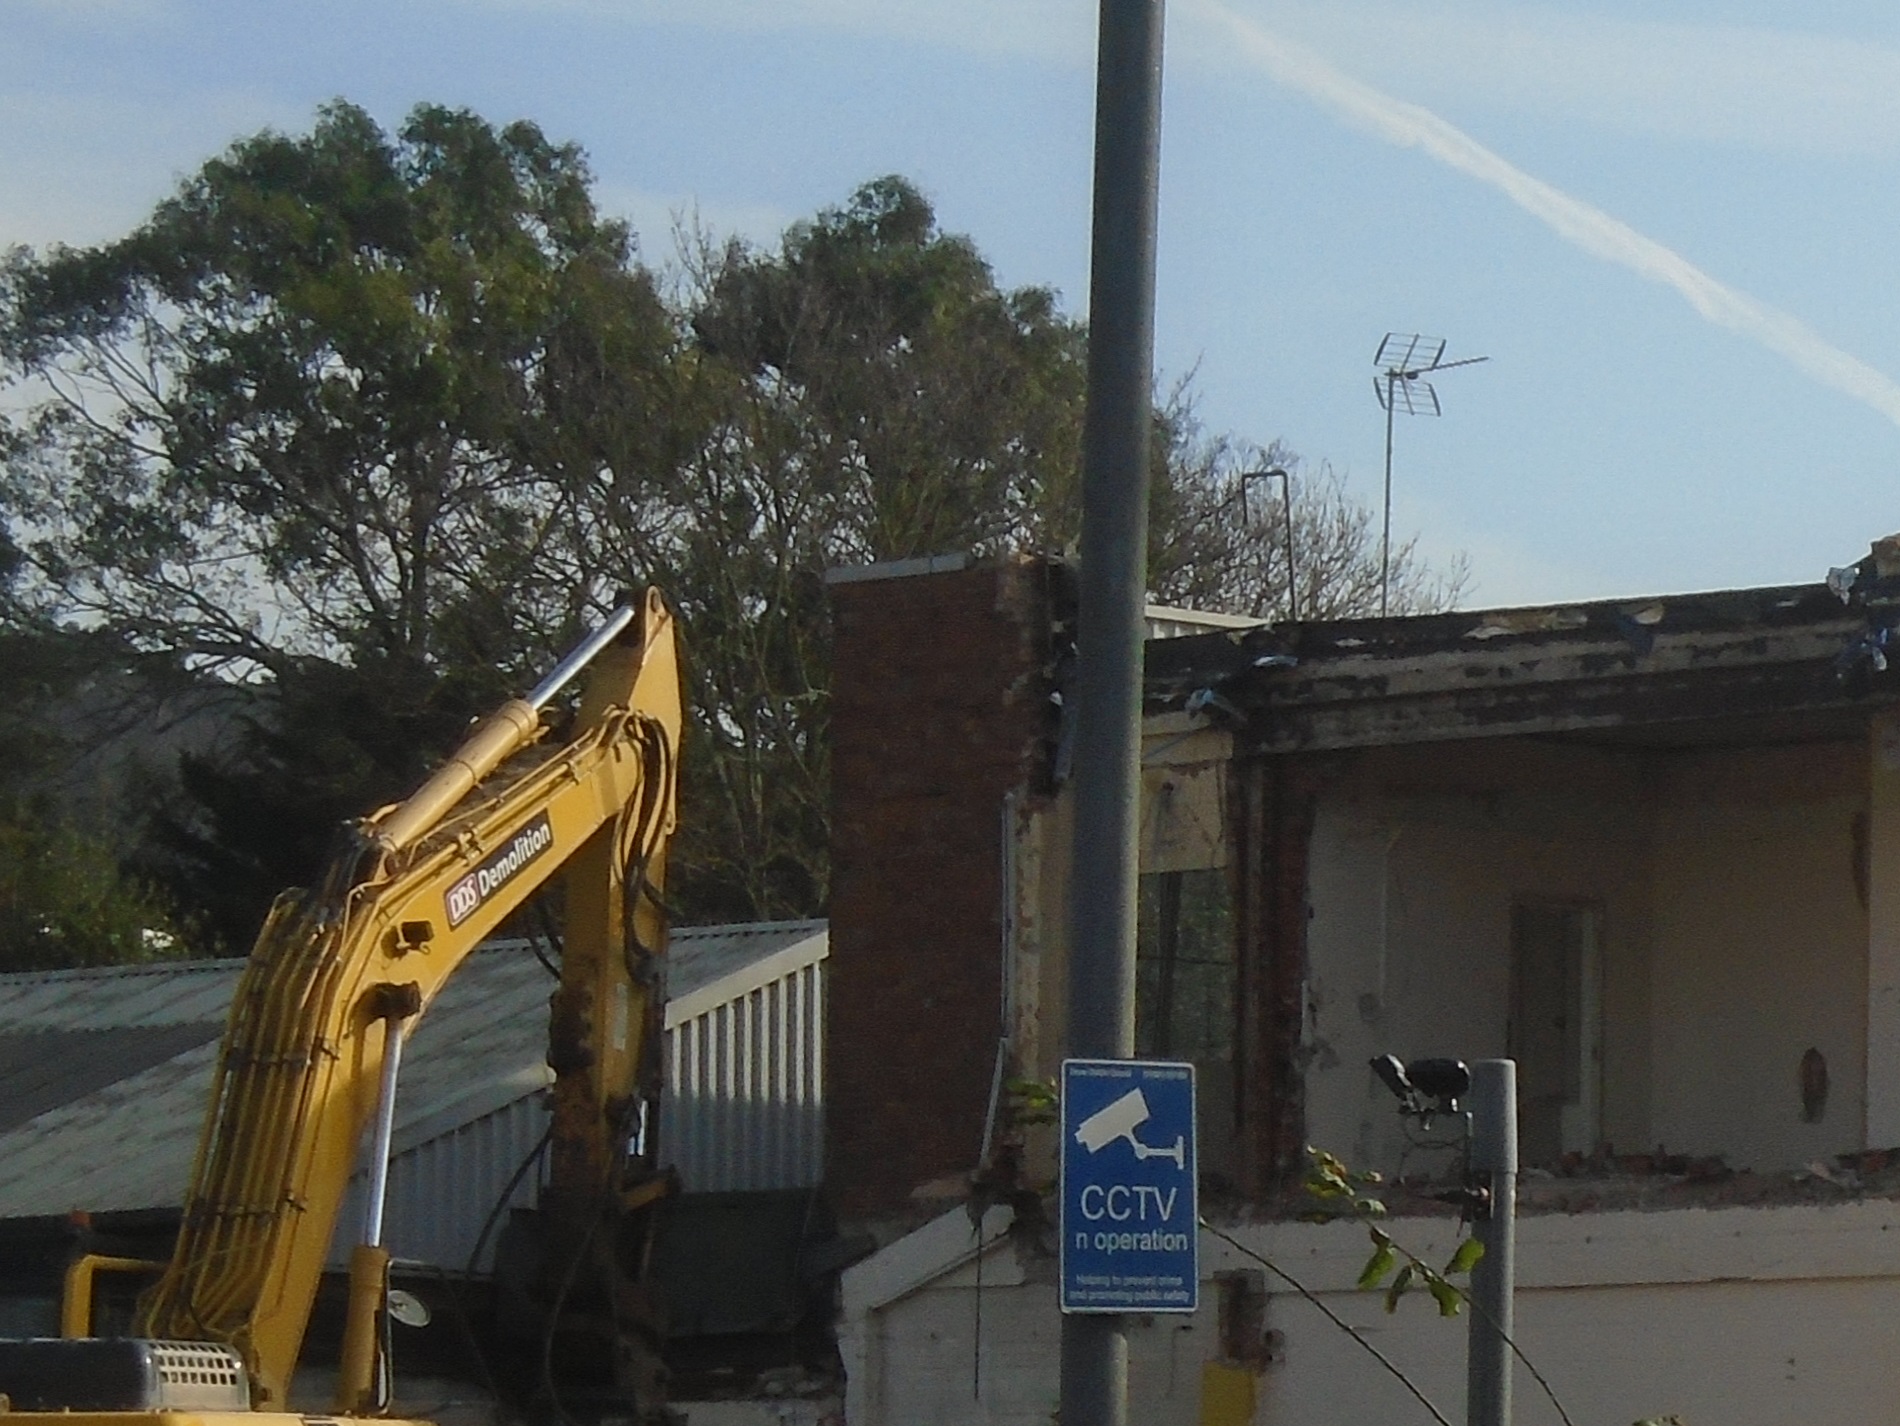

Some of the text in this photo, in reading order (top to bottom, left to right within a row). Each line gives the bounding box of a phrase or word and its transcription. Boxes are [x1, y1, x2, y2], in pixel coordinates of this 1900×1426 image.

[449, 823, 550, 920] DDS Demolition
[1081, 1185, 1177, 1221] CCTV
[1094, 1229, 1188, 1255] operation
